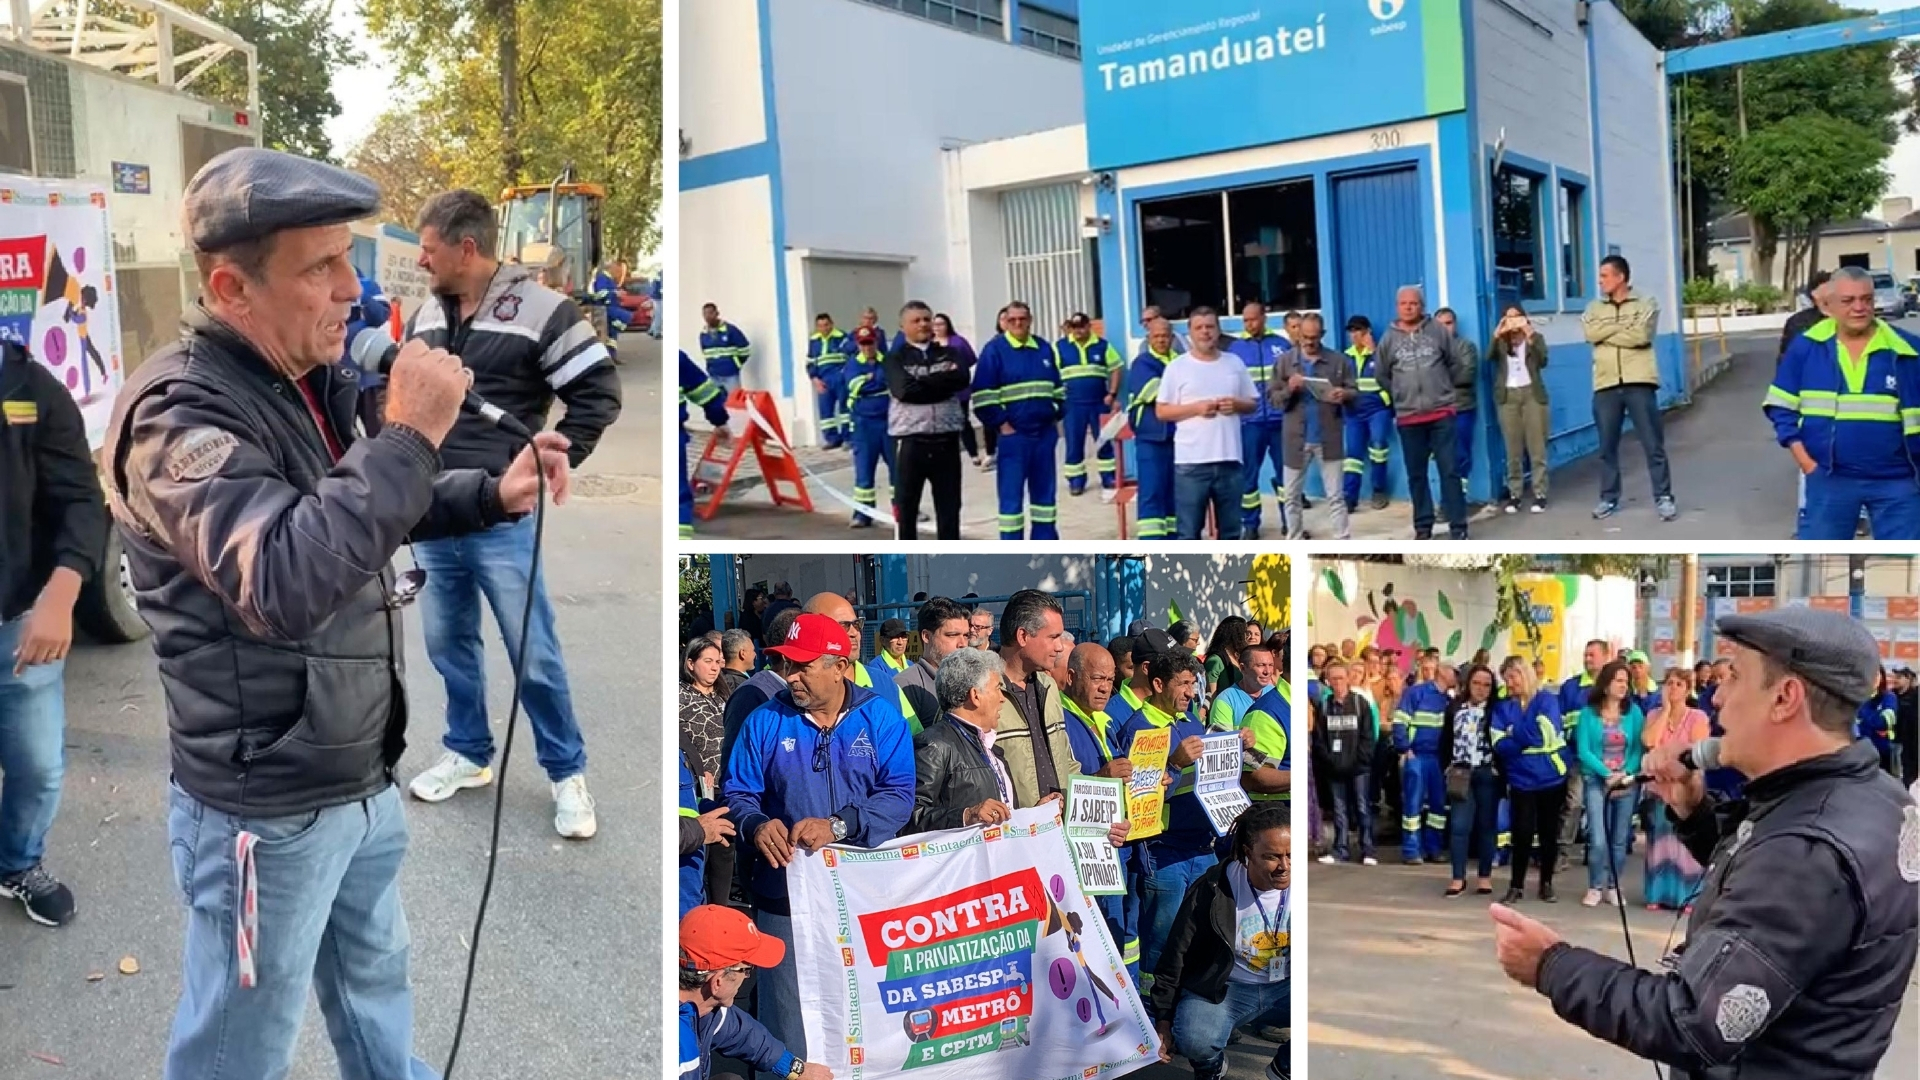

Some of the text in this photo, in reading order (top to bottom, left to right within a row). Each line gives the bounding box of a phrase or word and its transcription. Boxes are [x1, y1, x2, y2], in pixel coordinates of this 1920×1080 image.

[1135, 37, 1146, 48] de
[1147, 20, 1217, 44] Gerenciamento
[1218, 9, 1261, 28] Regional
[1370, 20, 1407, 36] sabesp
[1098, 14, 1326, 91] Tamanduateí
[1370, 128, 1401, 150] 300
[1199, 748, 1239, 775] 2 MILHÕES
[1070, 798, 1078, 822] A
[1081, 798, 1118, 824] SABESP
[846, 850, 901, 861] Sintaema
[928, 834, 983, 855] Sintaema
[1075, 841, 1098, 860] A SUA
[1081, 858, 1120, 887] OPINIÃO?
[829, 870, 850, 936] Sintaema
[880, 885, 1030, 949] CONTRA
[903, 927, 1032, 974] A PRIVATIZAÇÃO DA
[847, 969, 861, 1036] Sintaema
[886, 968, 1004, 1005] DA SABESP
[941, 991, 1021, 1028] METRÔ
[921, 1031, 994, 1062] E CPTM
